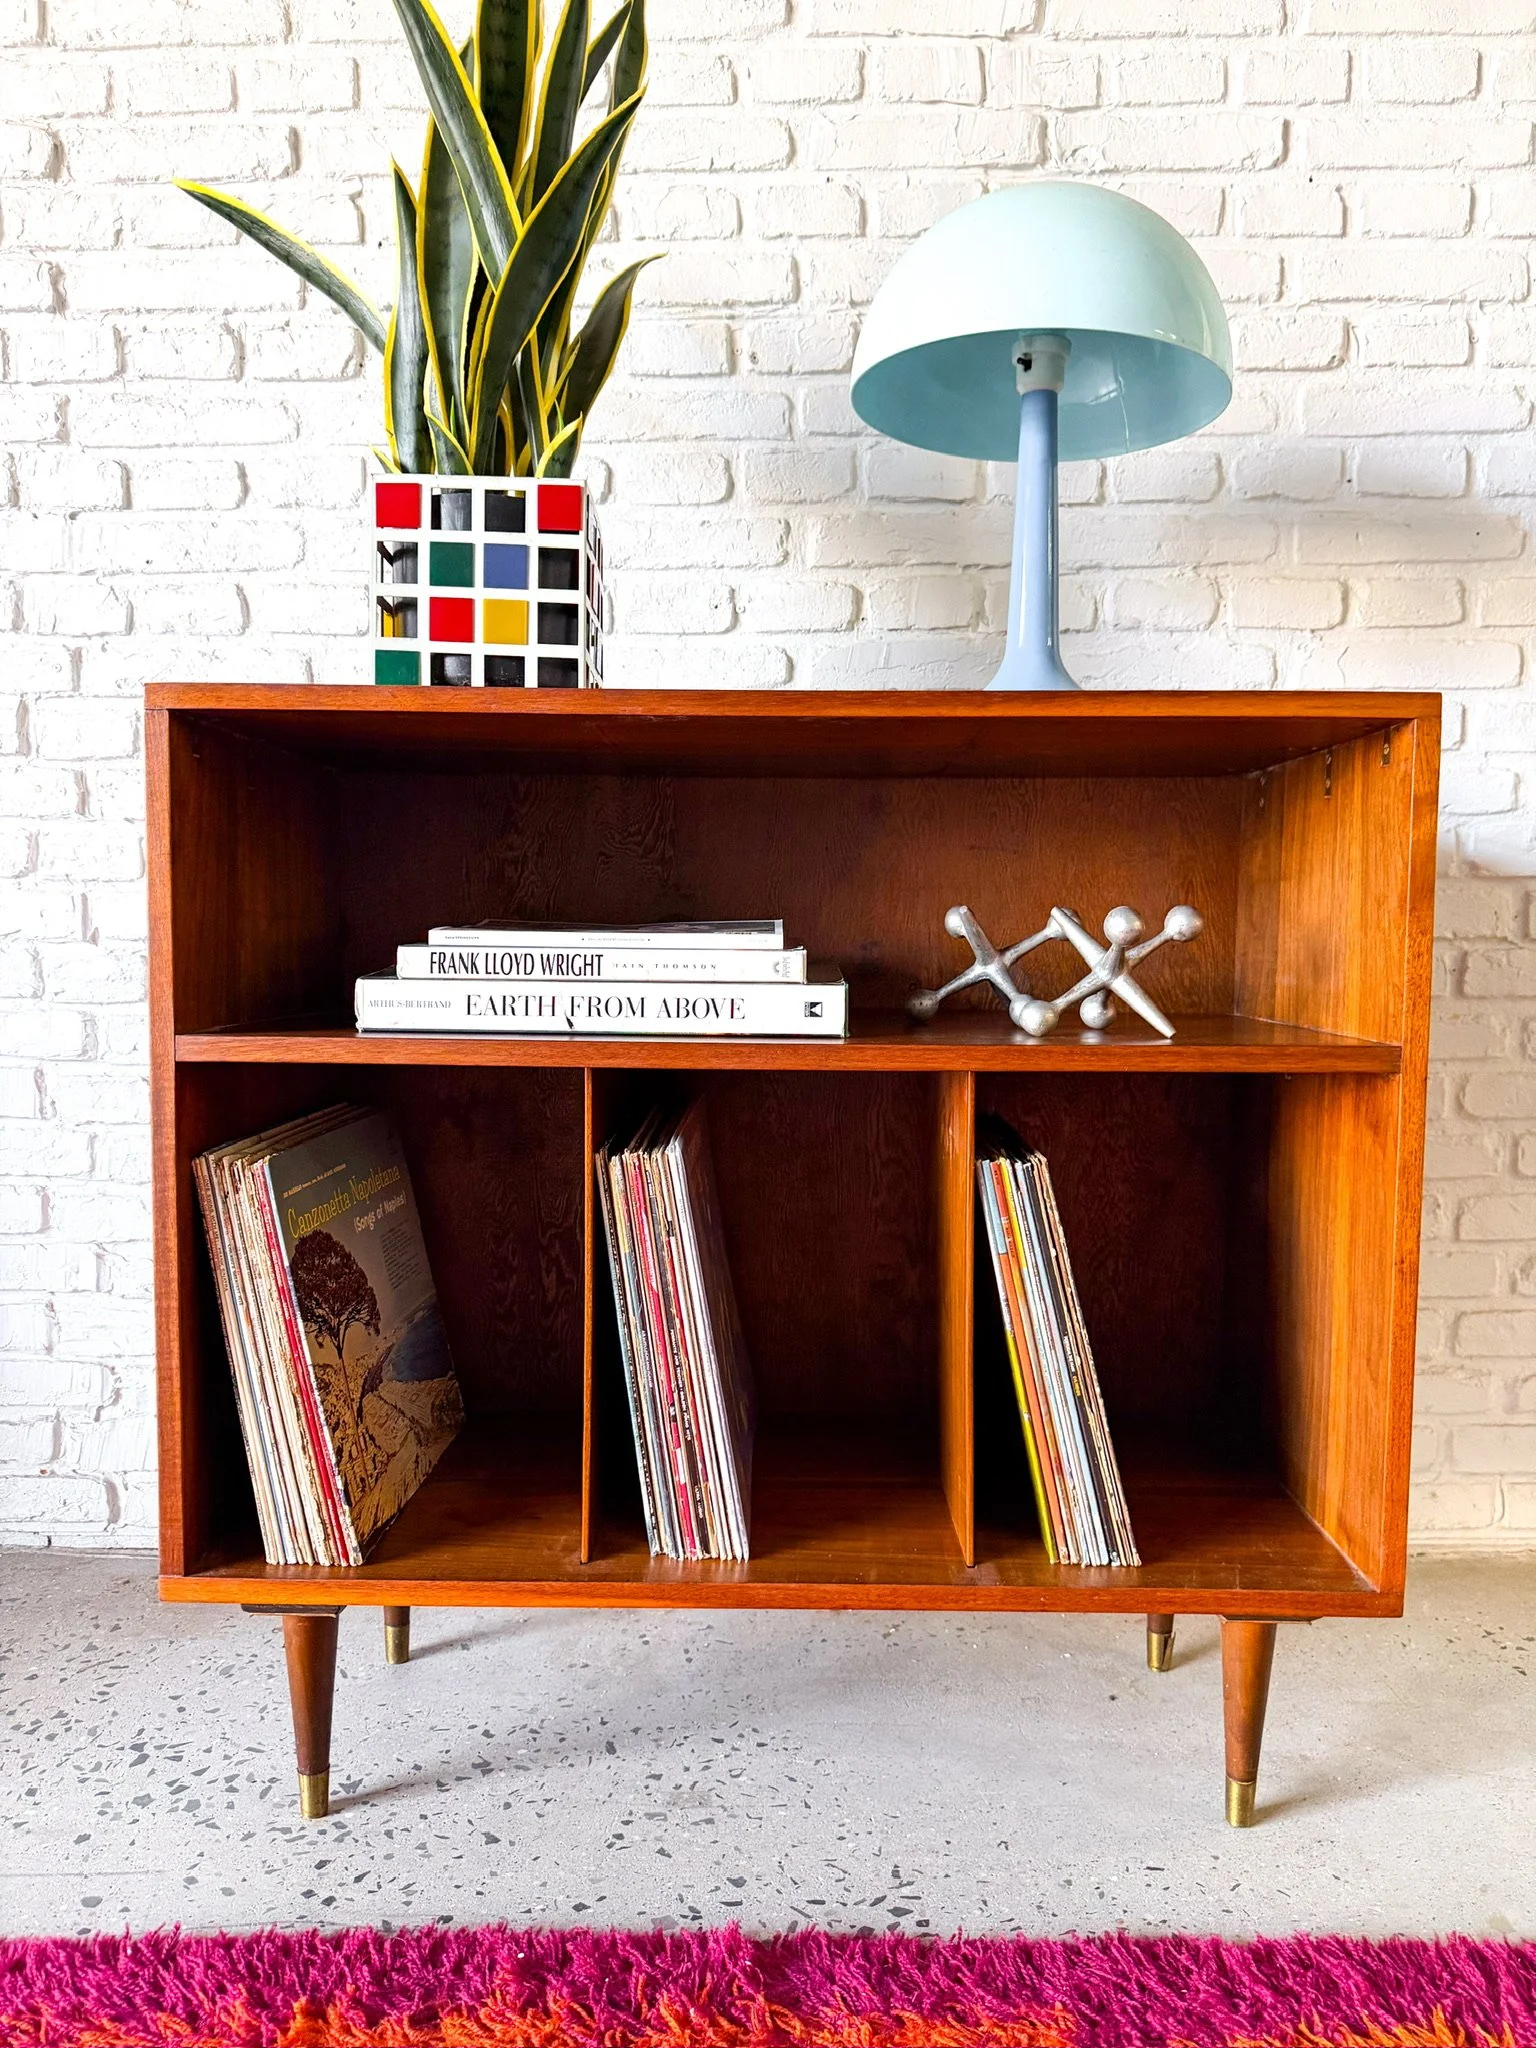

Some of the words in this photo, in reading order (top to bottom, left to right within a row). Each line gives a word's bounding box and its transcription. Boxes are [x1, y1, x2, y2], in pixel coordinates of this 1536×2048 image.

[430, 952, 480, 975] FRANK
[485, 952, 535, 976] LLOYD
[540, 953, 604, 977] WRIGHT
[367, 999, 452, 1009] ARTHUS-BERTRAND
[466, 994, 556, 1017] EARTH
[569, 995, 647, 1019] FROM
[656, 996, 746, 1020] ABOVE
[287, 1187, 352, 1239] Canzonetta
[349, 1165, 401, 1205] Napoletana
[353, 1211, 376, 1234] (Songs
